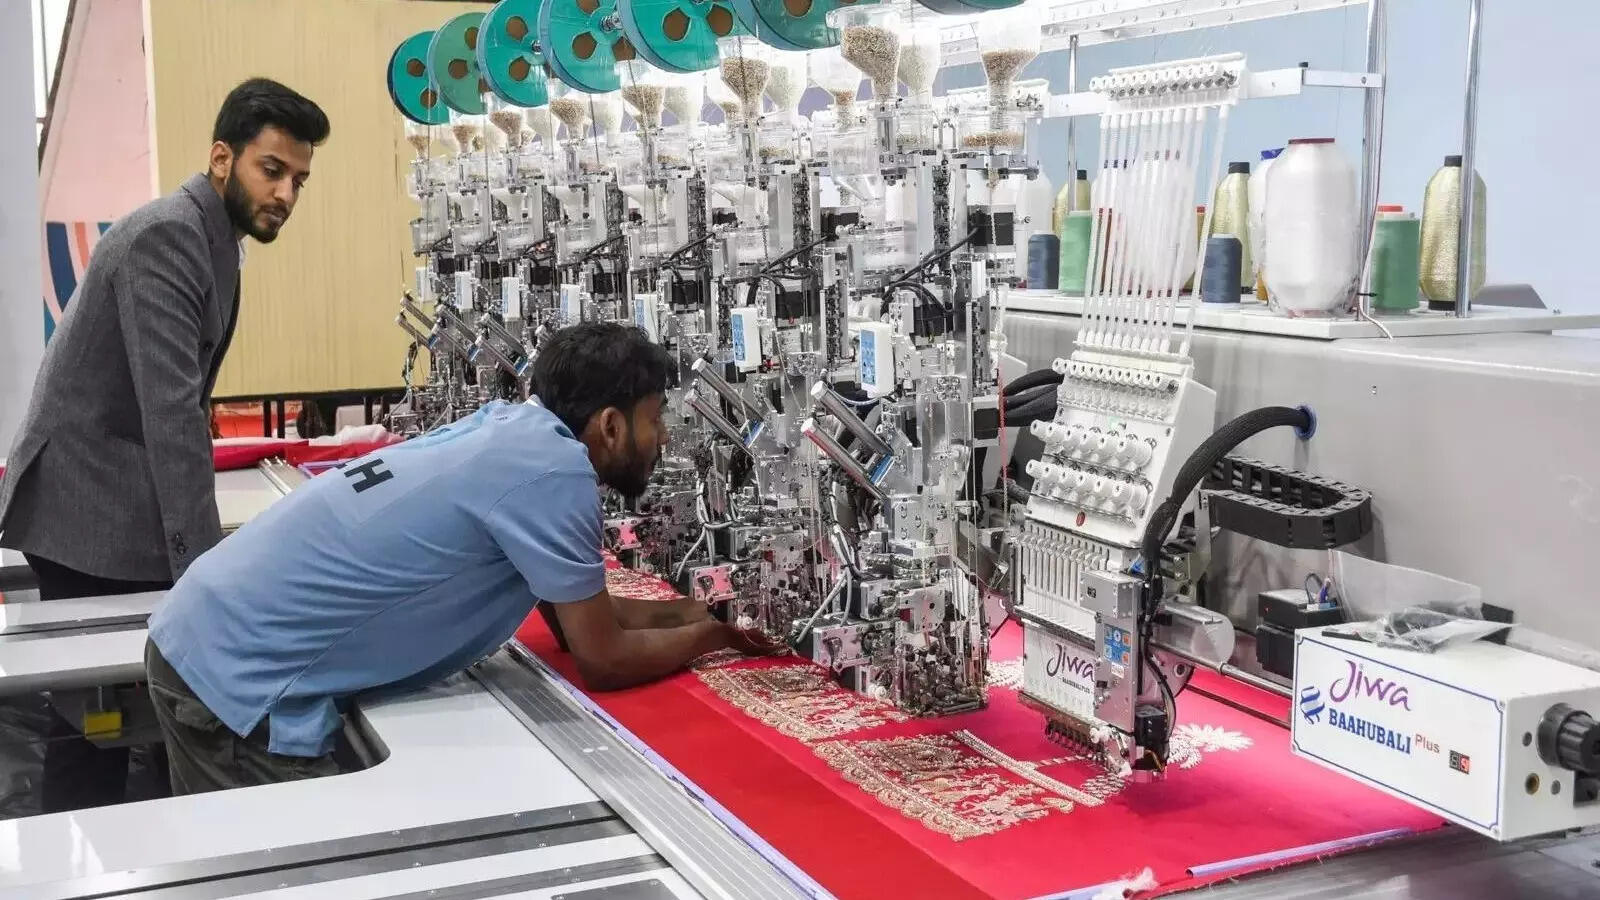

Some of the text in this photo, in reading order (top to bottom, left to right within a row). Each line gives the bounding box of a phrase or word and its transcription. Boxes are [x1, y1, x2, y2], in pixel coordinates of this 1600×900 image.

[1046, 643, 1095, 682] Jiwa
[1329, 660, 1411, 711] Jiwa
[1328, 707, 1440, 755] BAAHUBALI Plus
